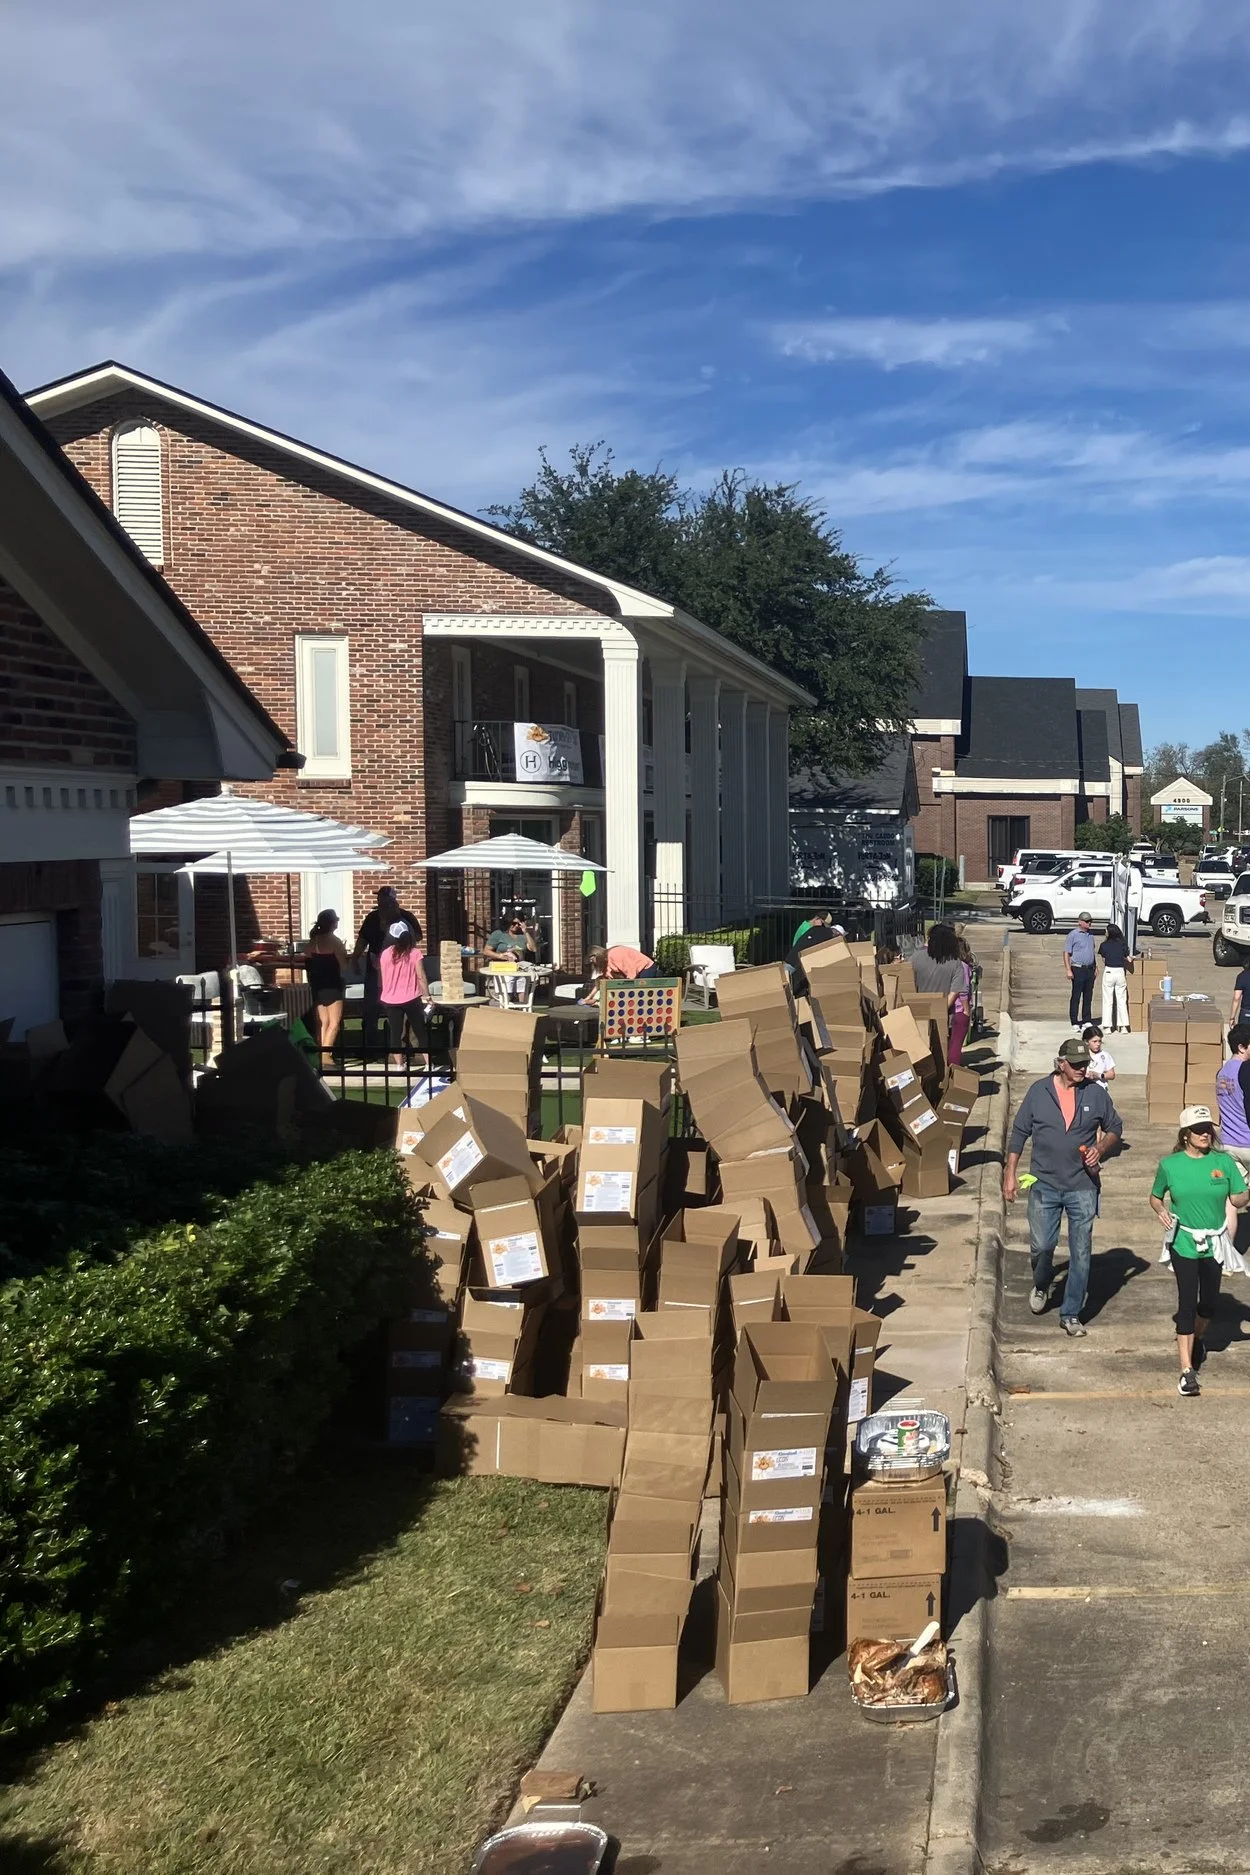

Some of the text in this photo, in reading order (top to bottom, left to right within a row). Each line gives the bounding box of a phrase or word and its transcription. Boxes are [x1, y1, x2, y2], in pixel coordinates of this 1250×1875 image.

[525, 755, 537, 769] H
[874, 1507, 896, 1515] GAL.
[869, 1591, 890, 1599] GAL.
